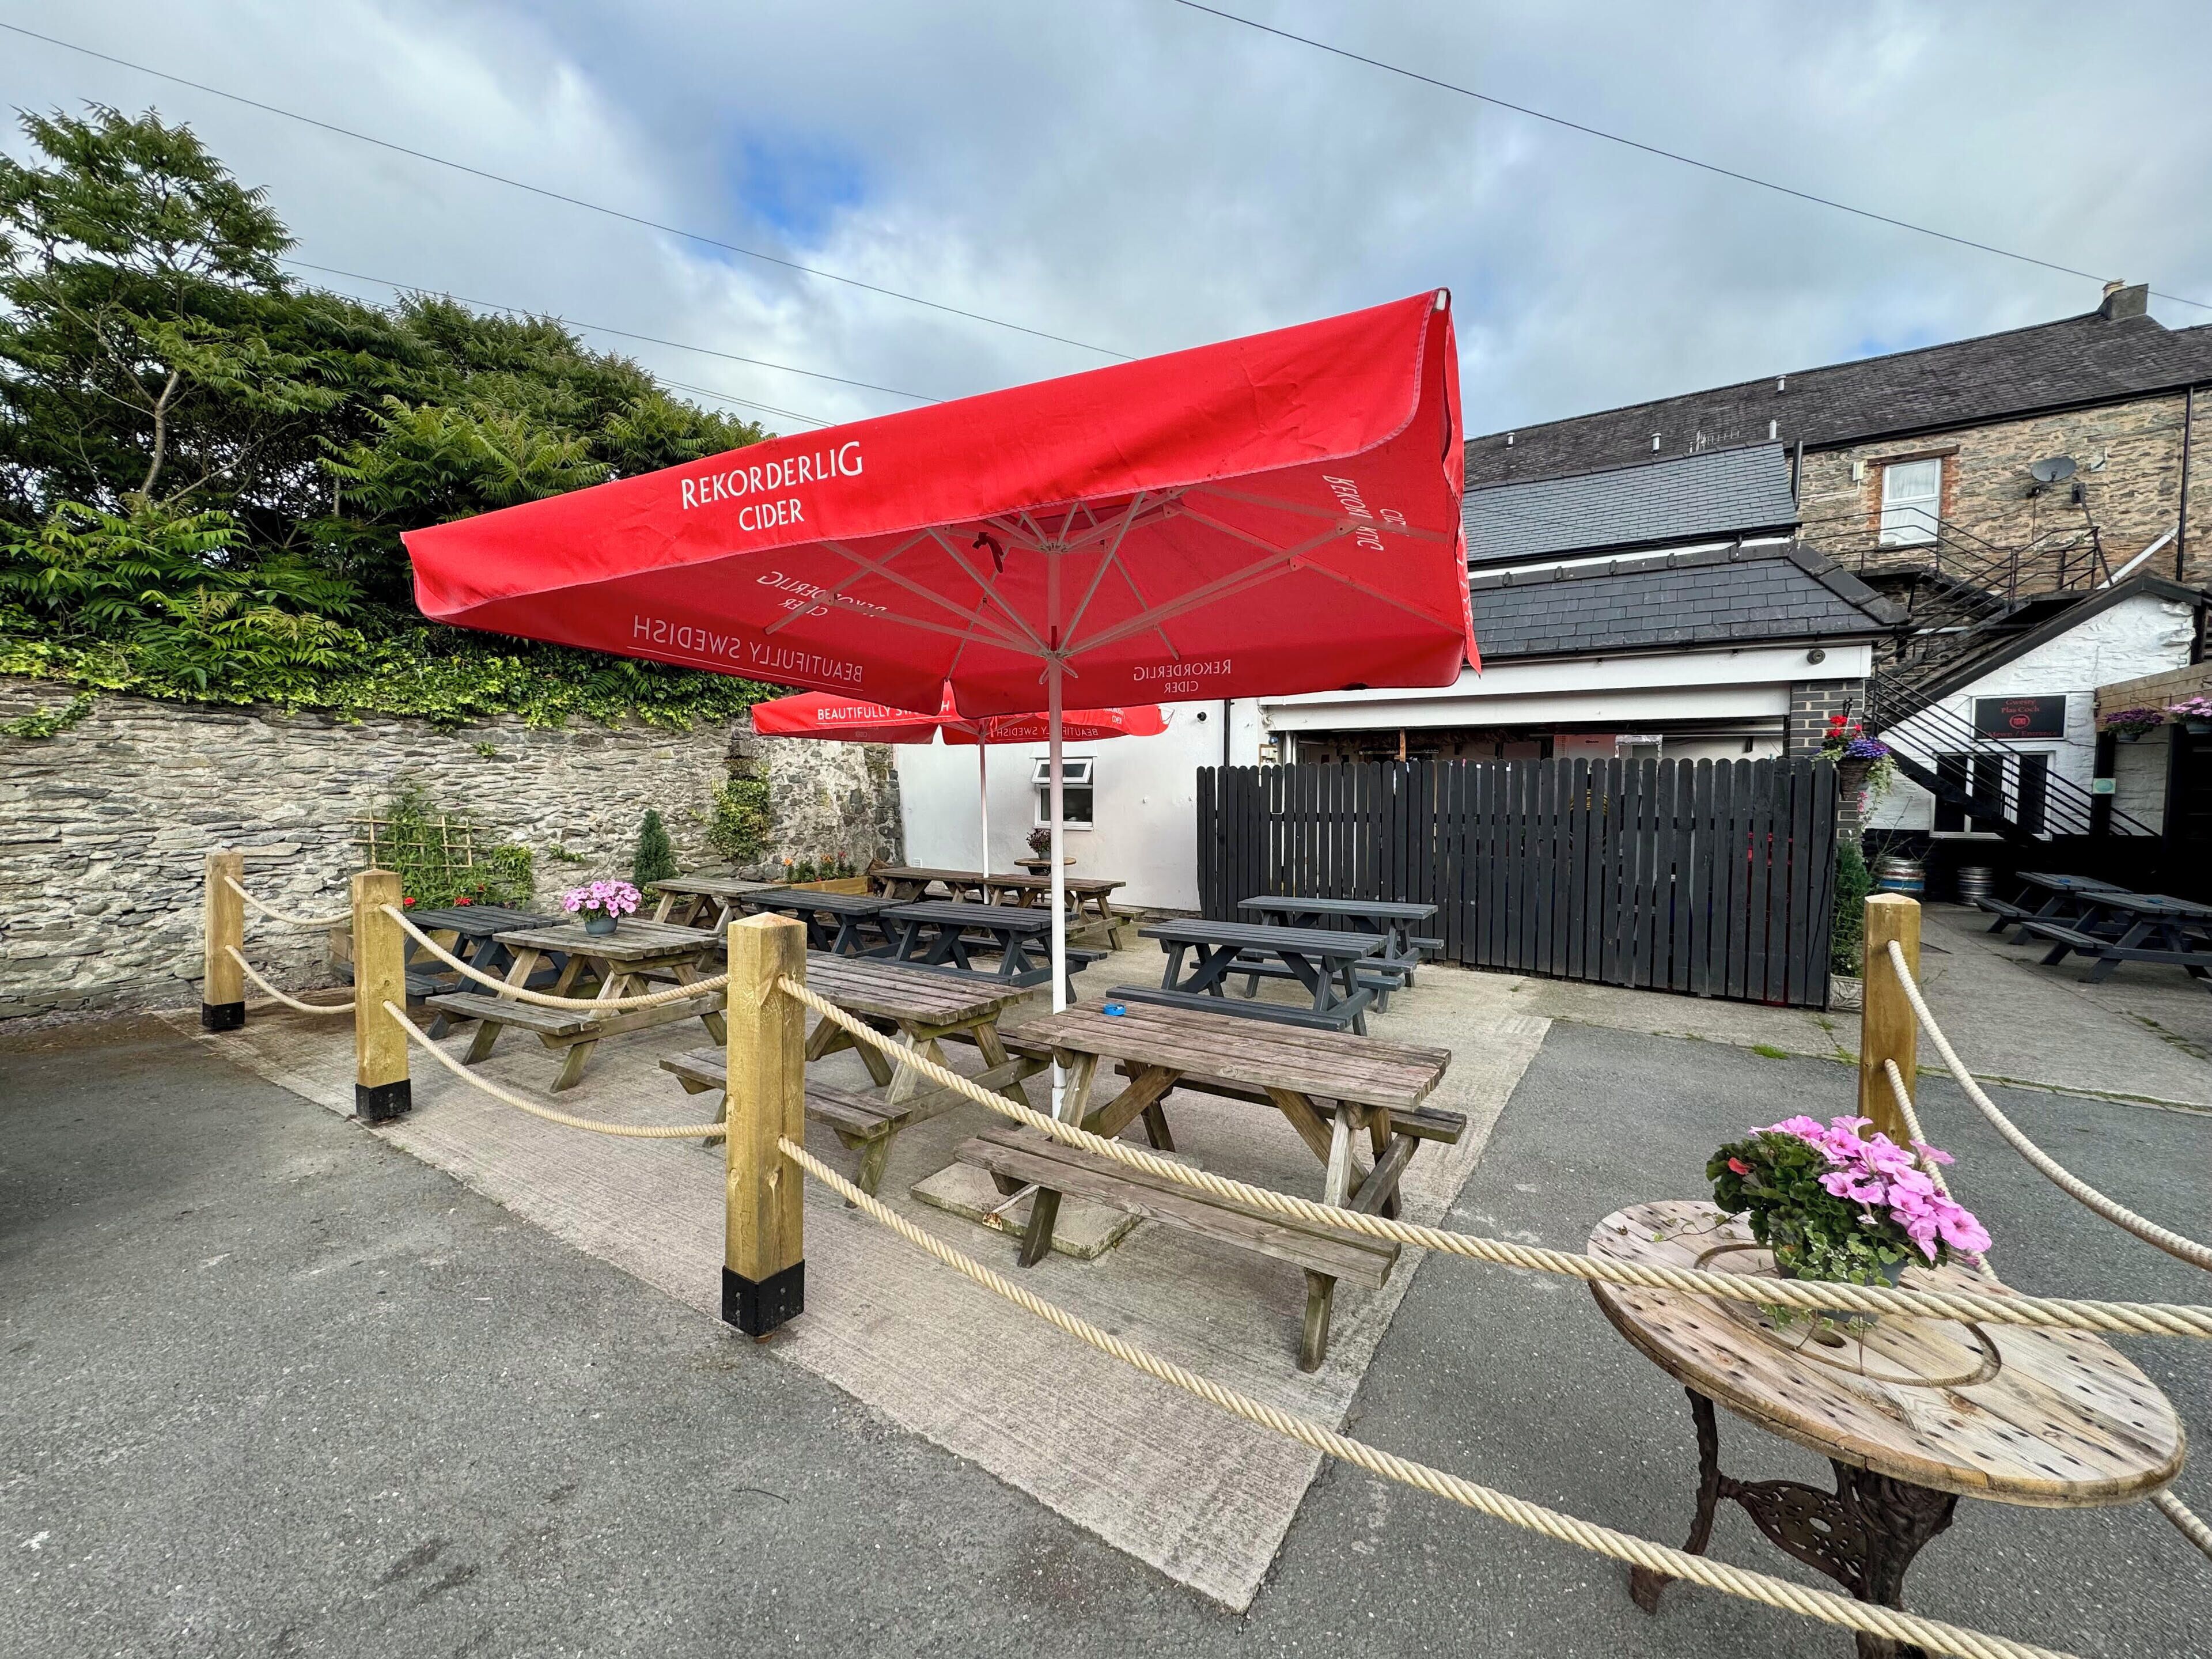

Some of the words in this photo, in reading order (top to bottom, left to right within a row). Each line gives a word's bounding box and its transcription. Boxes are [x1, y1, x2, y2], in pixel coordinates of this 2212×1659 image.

[681, 441, 863, 510] REKORDERLIG
[738, 498, 805, 531] CIDER
[817, 704, 891, 720] BEAUTIFULLY
